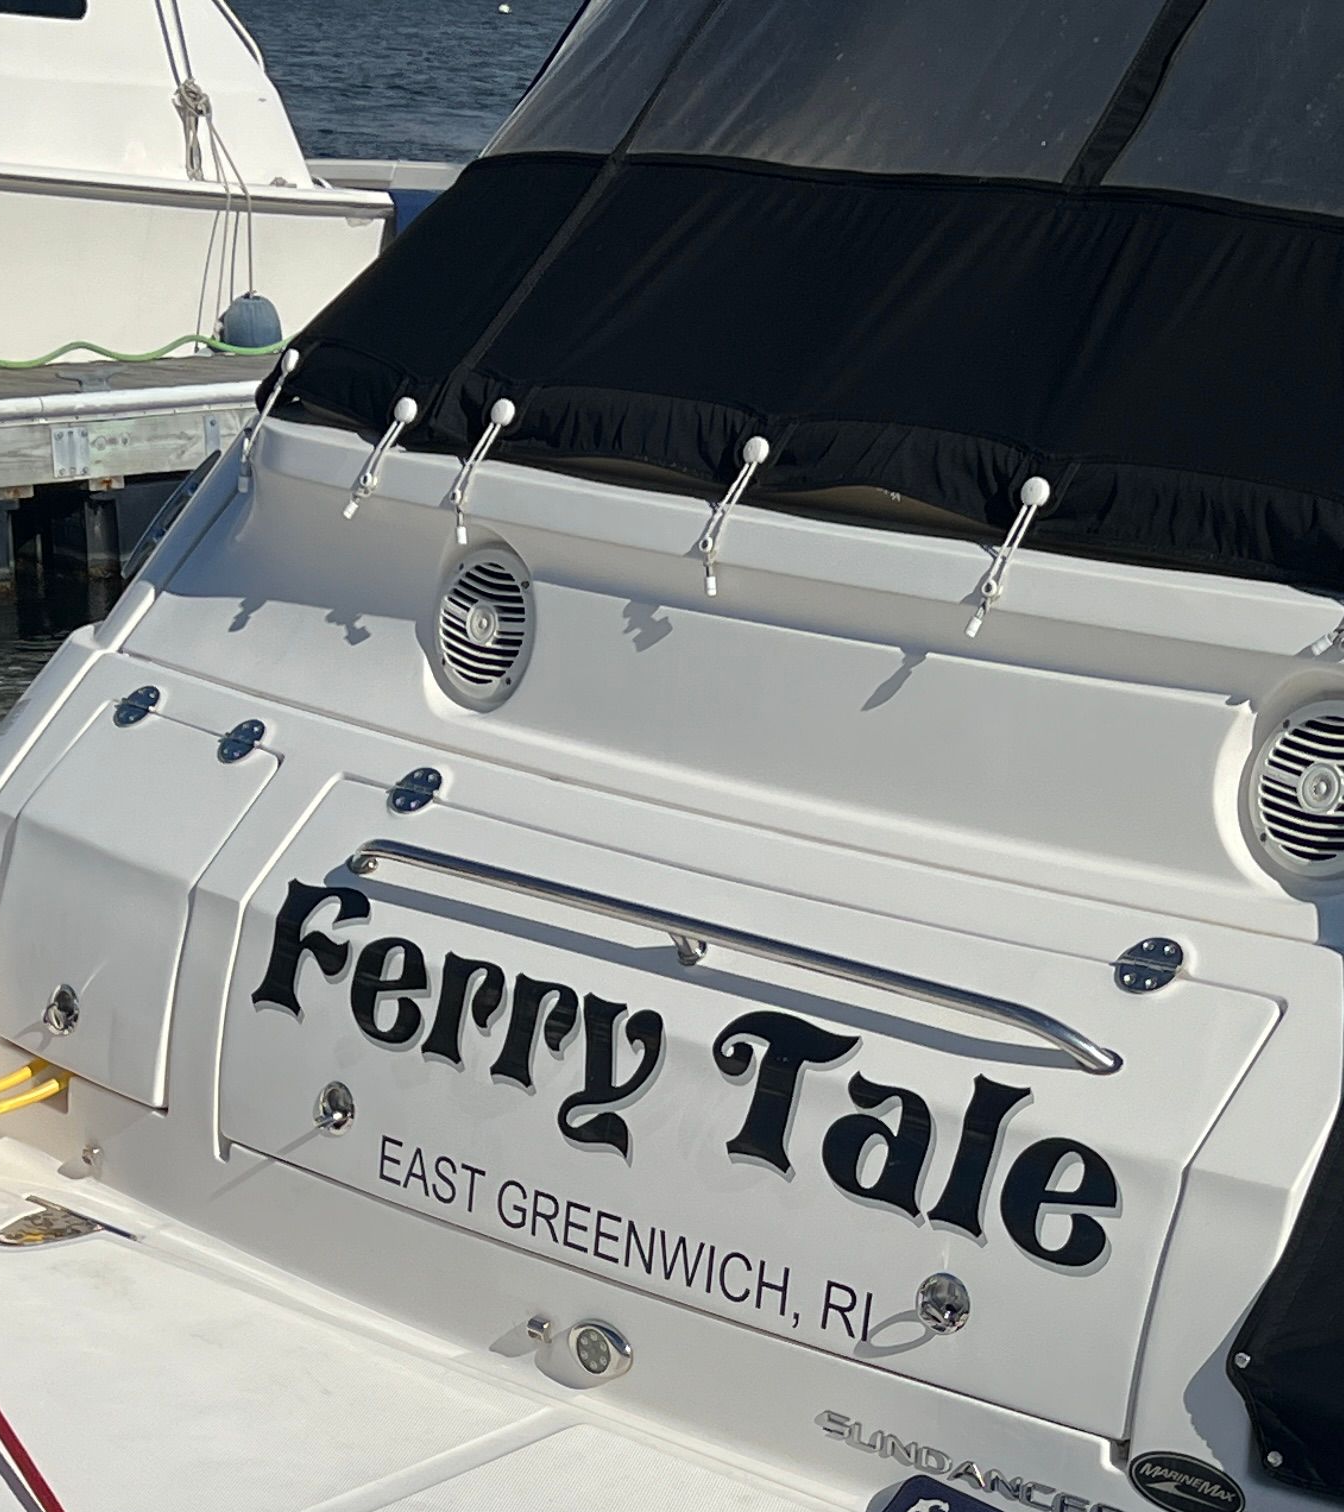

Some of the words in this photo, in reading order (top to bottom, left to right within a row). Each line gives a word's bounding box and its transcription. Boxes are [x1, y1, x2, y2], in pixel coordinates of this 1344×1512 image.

[251, 879, 665, 1164] Ferry
[712, 1009, 1121, 1271] Tale
[377, 1134, 486, 1213] EAST
[496, 1180, 802, 1328] GREENWICH,
[822, 1281, 874, 1342] RI
